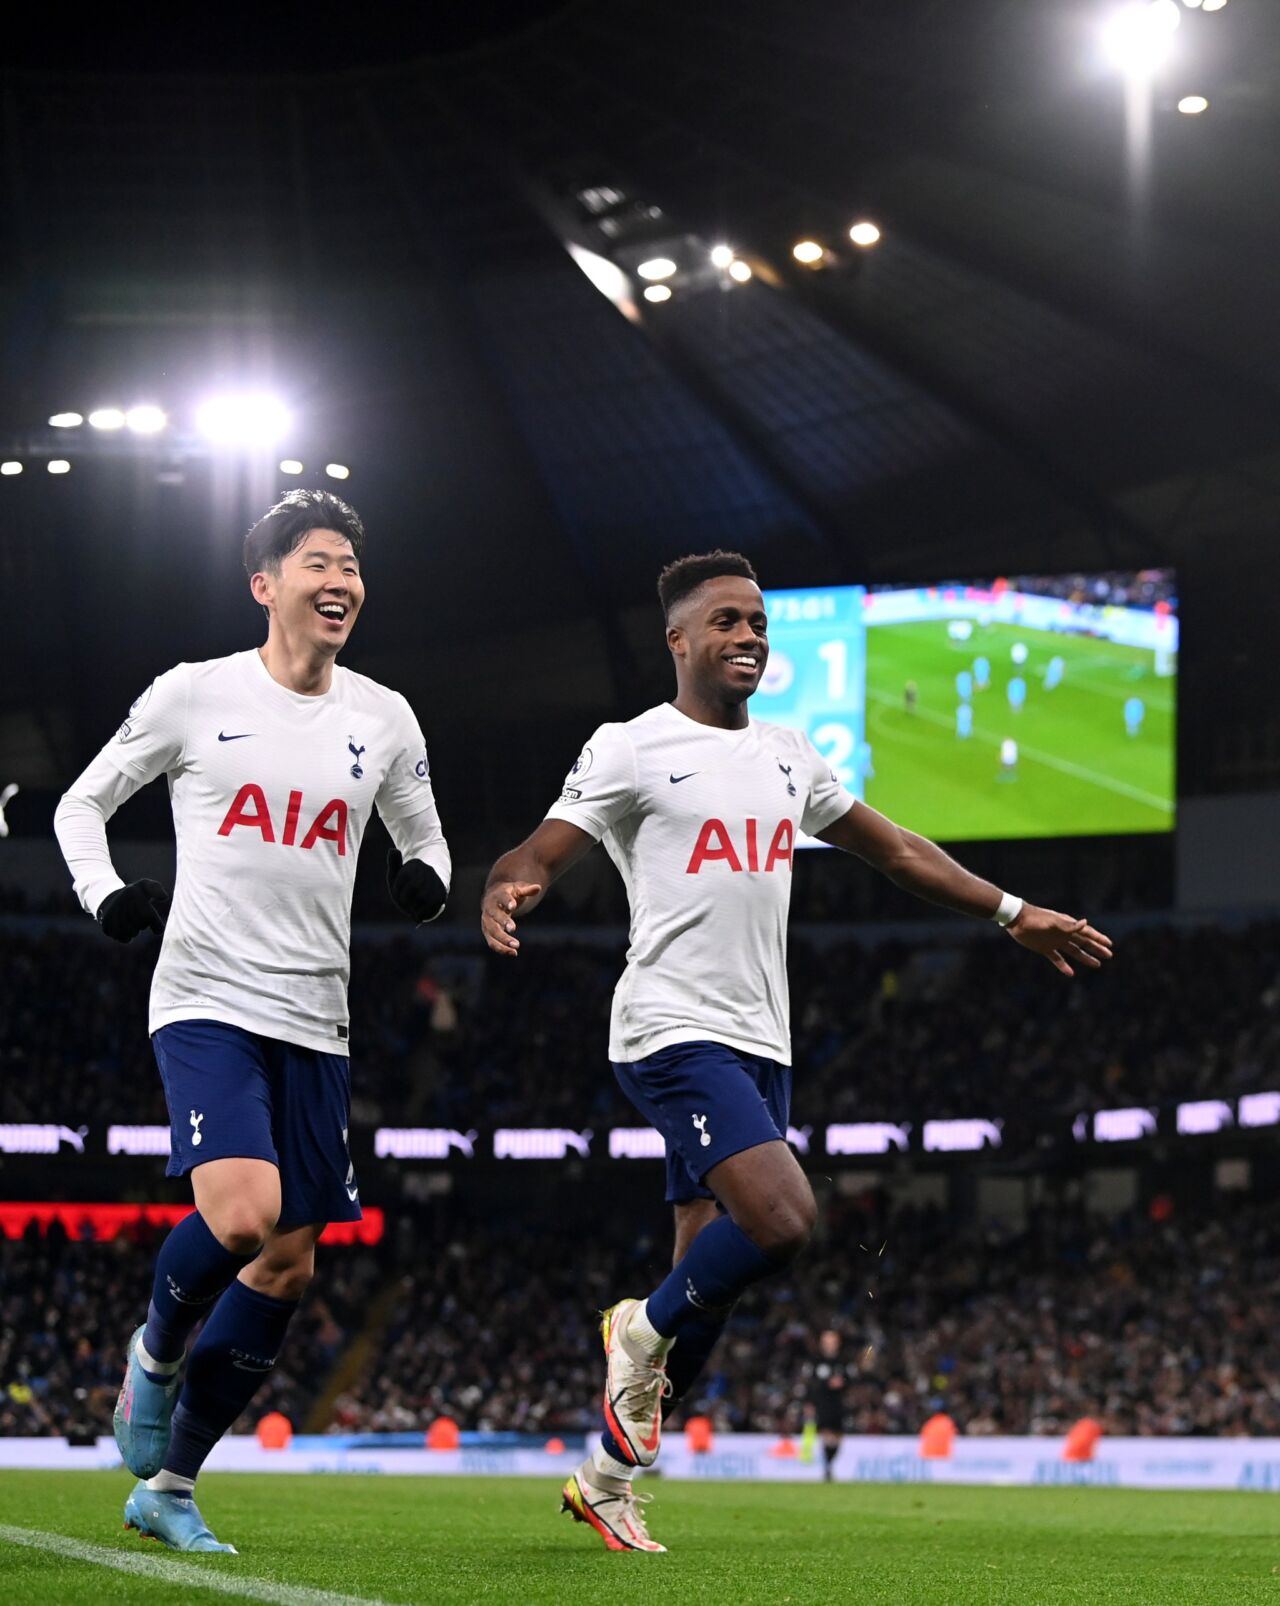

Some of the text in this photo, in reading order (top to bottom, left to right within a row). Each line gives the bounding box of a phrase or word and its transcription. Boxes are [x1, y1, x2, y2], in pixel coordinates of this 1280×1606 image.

[818, 640, 848, 699] 1
[813, 723, 855, 784] 2
[217, 783, 348, 857] AIA
[685, 818, 793, 875] AIA
